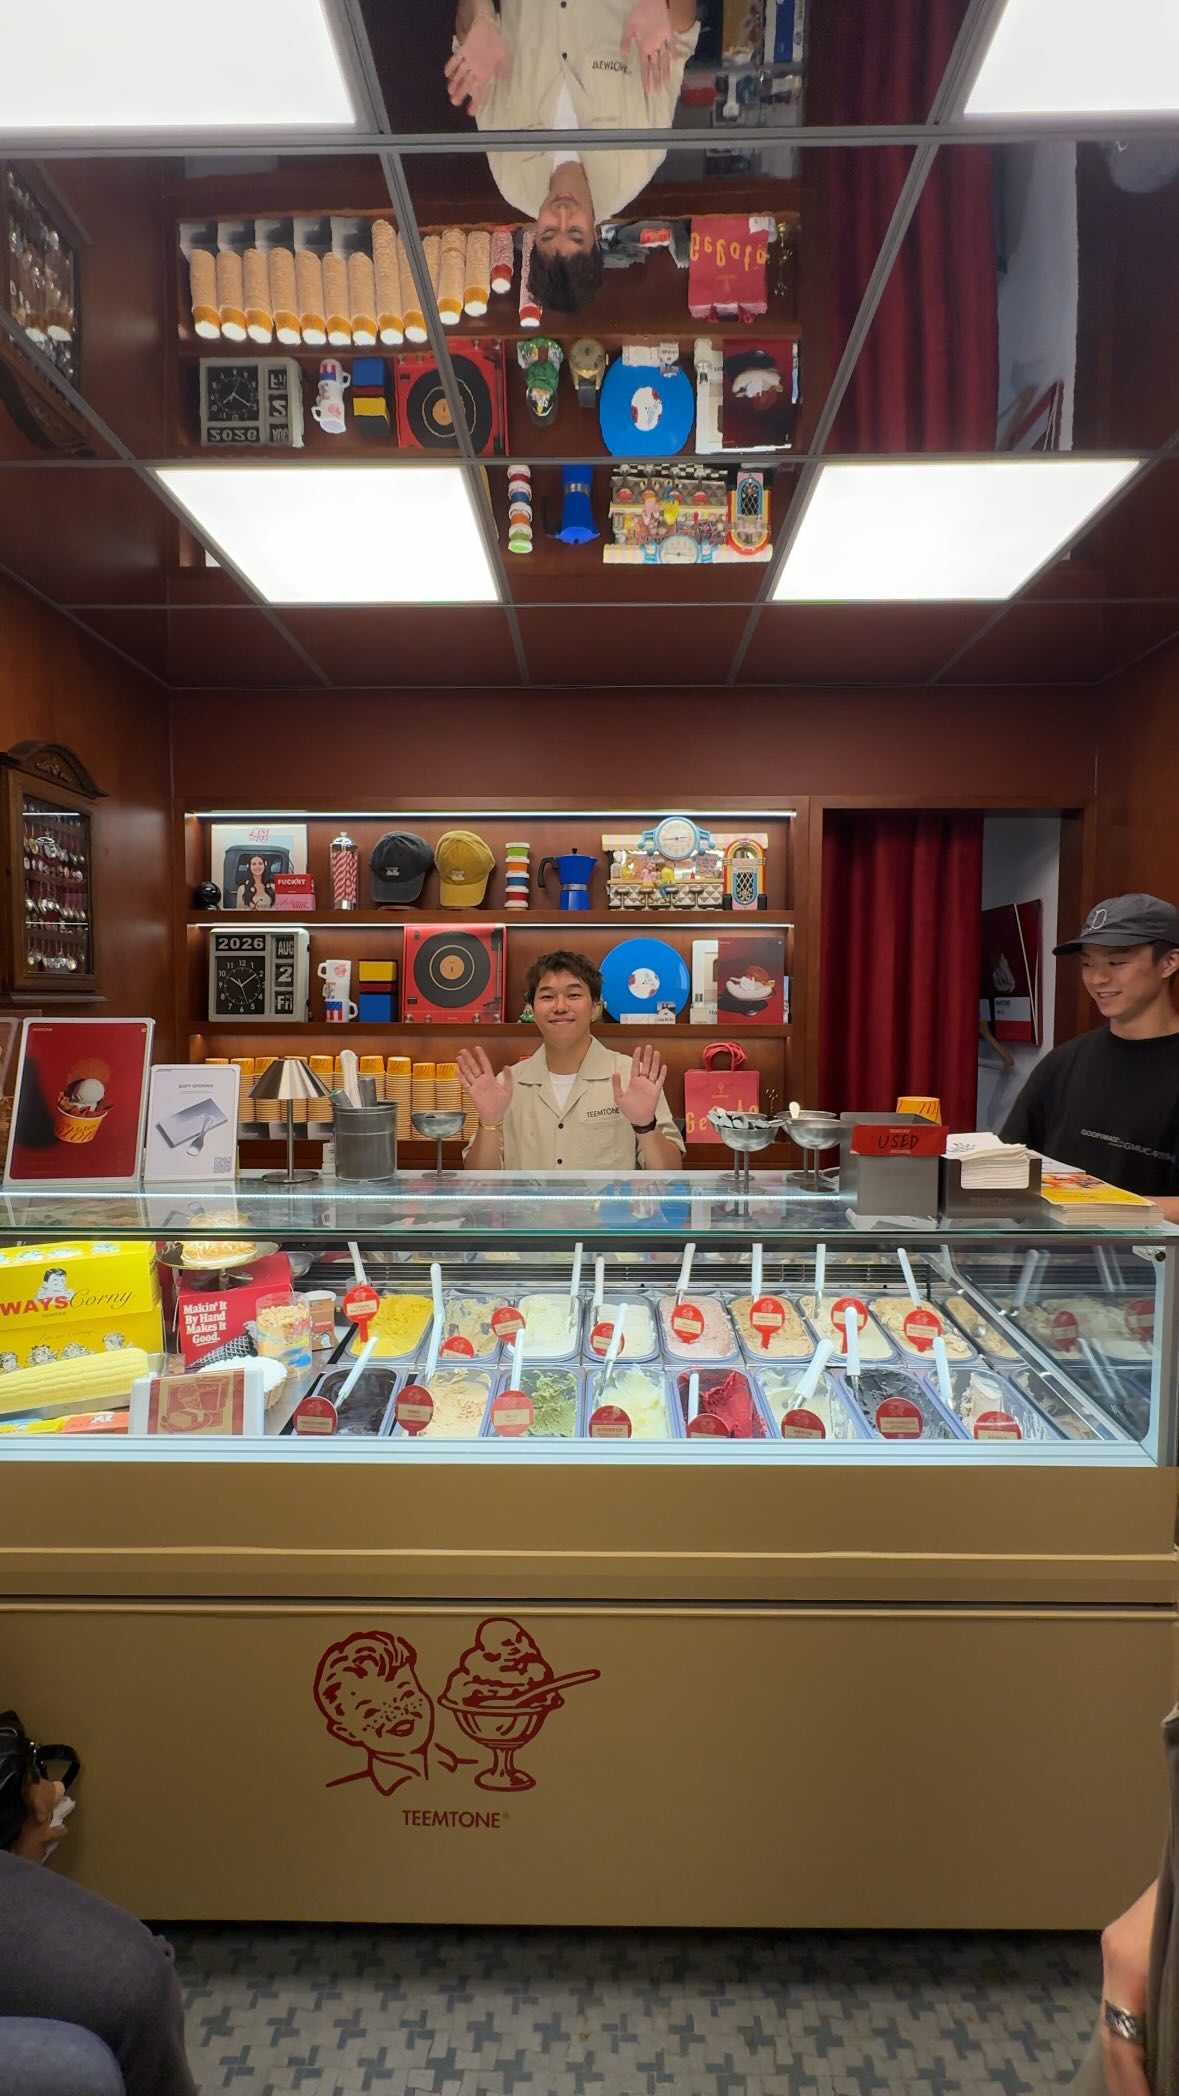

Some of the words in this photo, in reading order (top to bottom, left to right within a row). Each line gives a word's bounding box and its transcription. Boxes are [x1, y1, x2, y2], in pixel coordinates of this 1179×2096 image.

[1089, 909, 1107, 931] D
[218, 938, 264, 949] 2026
[278, 941, 294, 955] AUG
[278, 967, 292, 982] 2
[586, 1107, 620, 1118] TEEMTONE
[878, 1135, 919, 1149] USED
[0, 1296, 69, 1316] WAYS
[70, 1289, 133, 1310] Corny
[183, 1302, 218, 1314] Makin'
[219, 1301, 227, 1310] It
[185, 1315, 199, 1325] By
[200, 1311, 226, 1322] Hand
[186, 1324, 218, 1334] Makes
[219, 1322, 227, 1330] It
[192, 1332, 220, 1344] Good.
